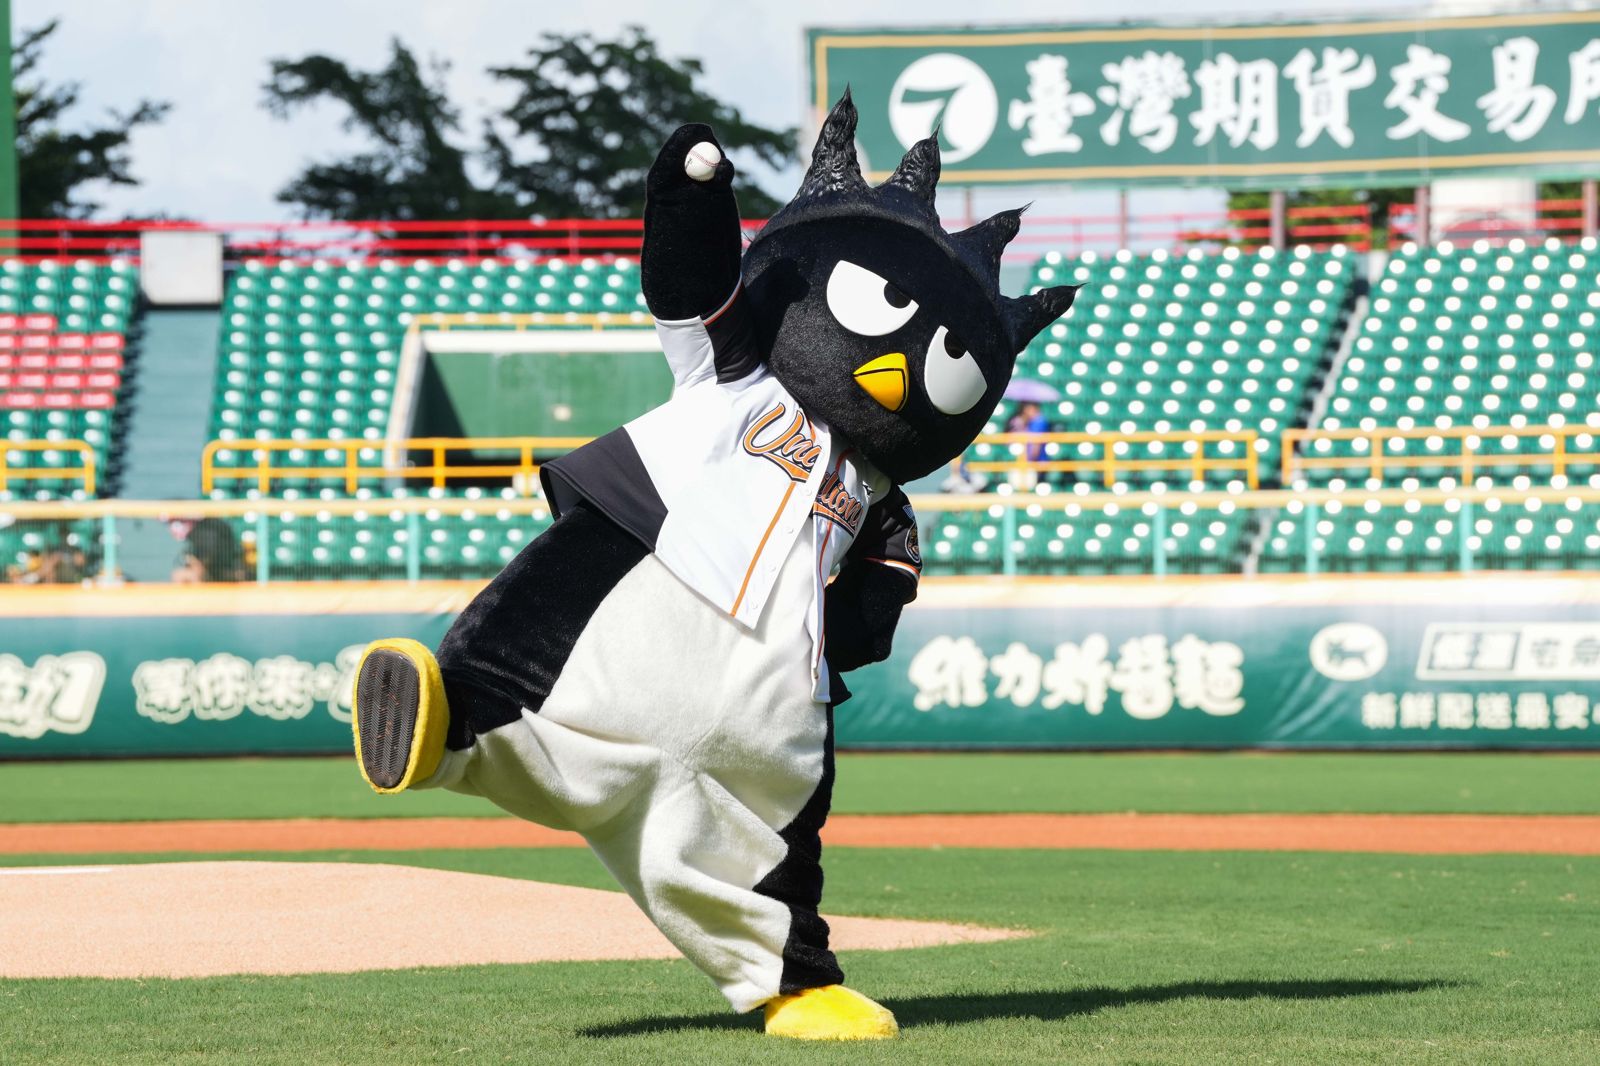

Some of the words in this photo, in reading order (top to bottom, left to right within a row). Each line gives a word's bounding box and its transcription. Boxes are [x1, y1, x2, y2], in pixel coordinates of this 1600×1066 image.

[1361, 691, 1600, 730] 新鮮配送最安
